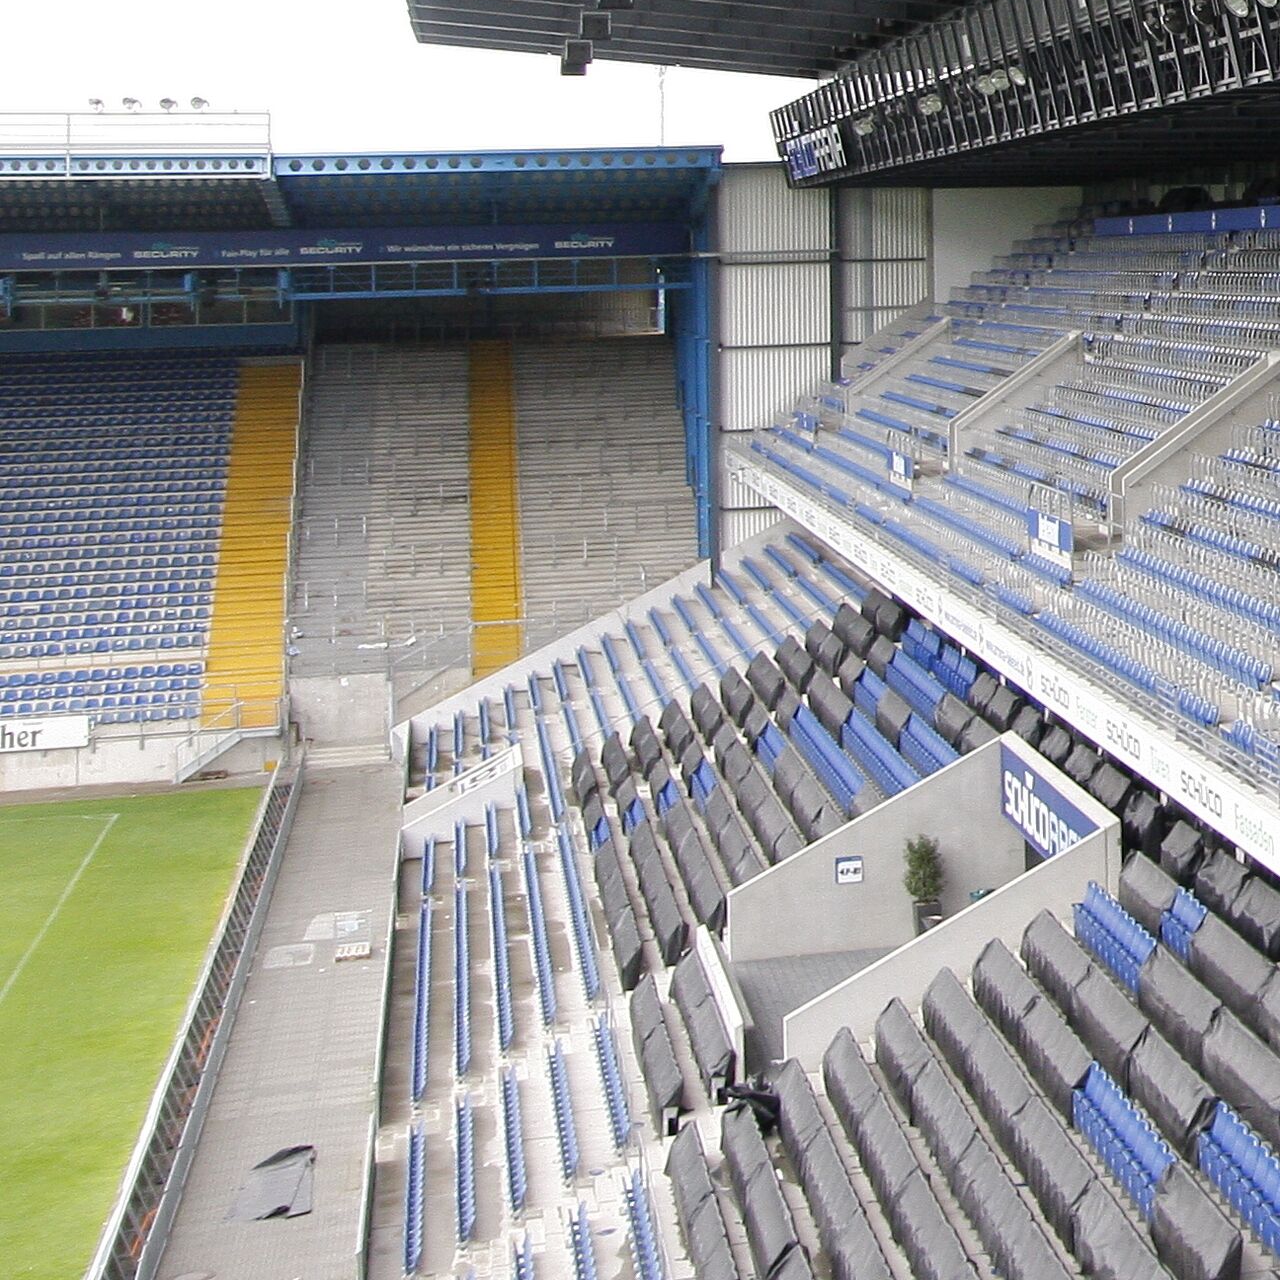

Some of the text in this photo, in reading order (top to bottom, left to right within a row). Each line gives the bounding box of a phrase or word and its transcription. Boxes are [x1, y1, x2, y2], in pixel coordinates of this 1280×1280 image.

[554, 240, 614, 249] SECURITY
[133, 249, 199, 259] SECURITY
[300, 245, 362, 255] SECURITY
[1181, 769, 1223, 819] SCHÜCO
